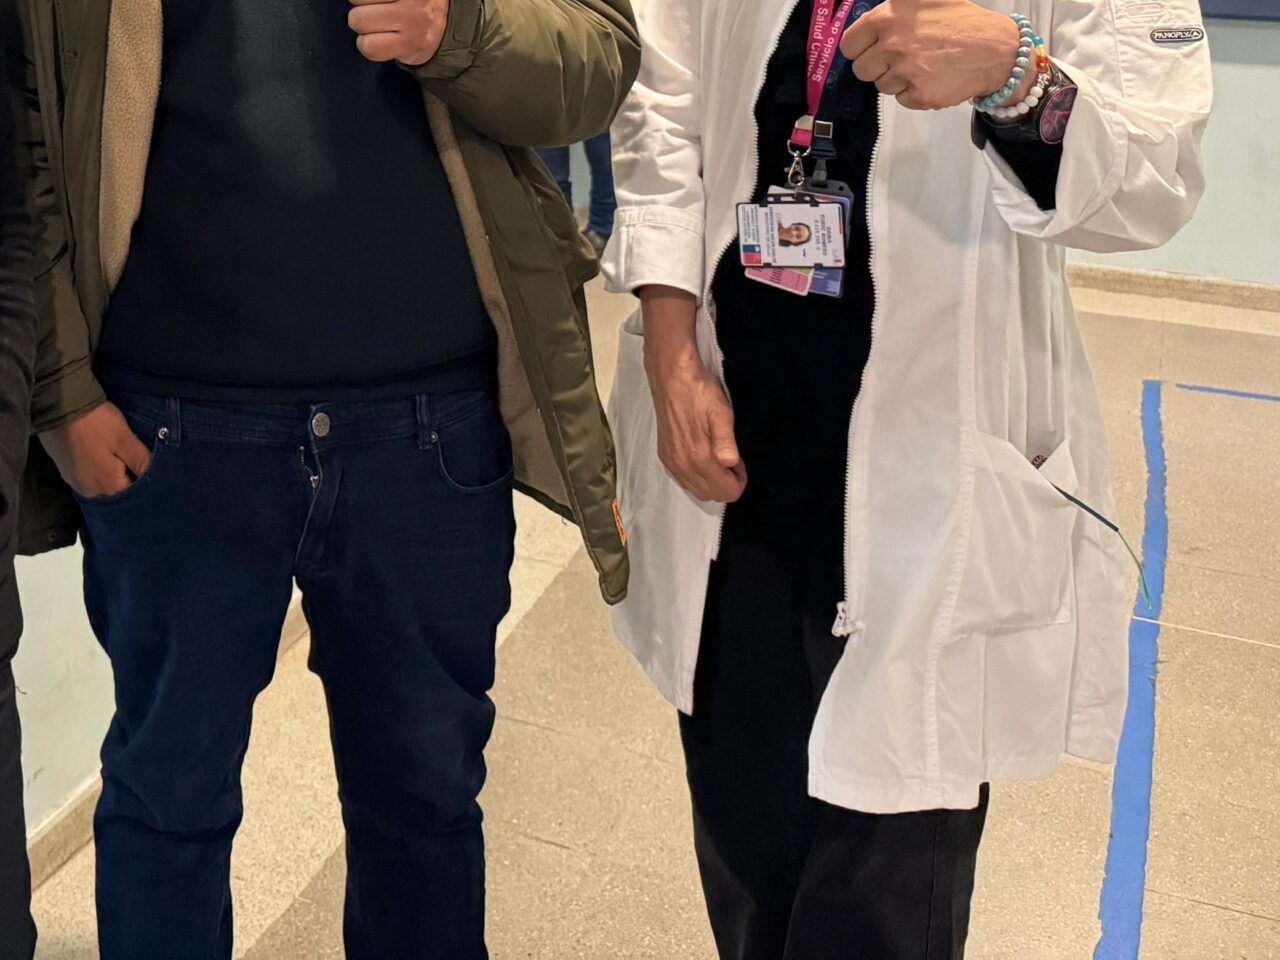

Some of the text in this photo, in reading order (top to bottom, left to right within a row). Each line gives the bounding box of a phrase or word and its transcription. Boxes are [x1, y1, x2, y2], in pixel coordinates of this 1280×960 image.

[813, 7, 828, 40] Salud
[812, 37, 835, 82] Servicio
[831, 21, 841, 35] de
